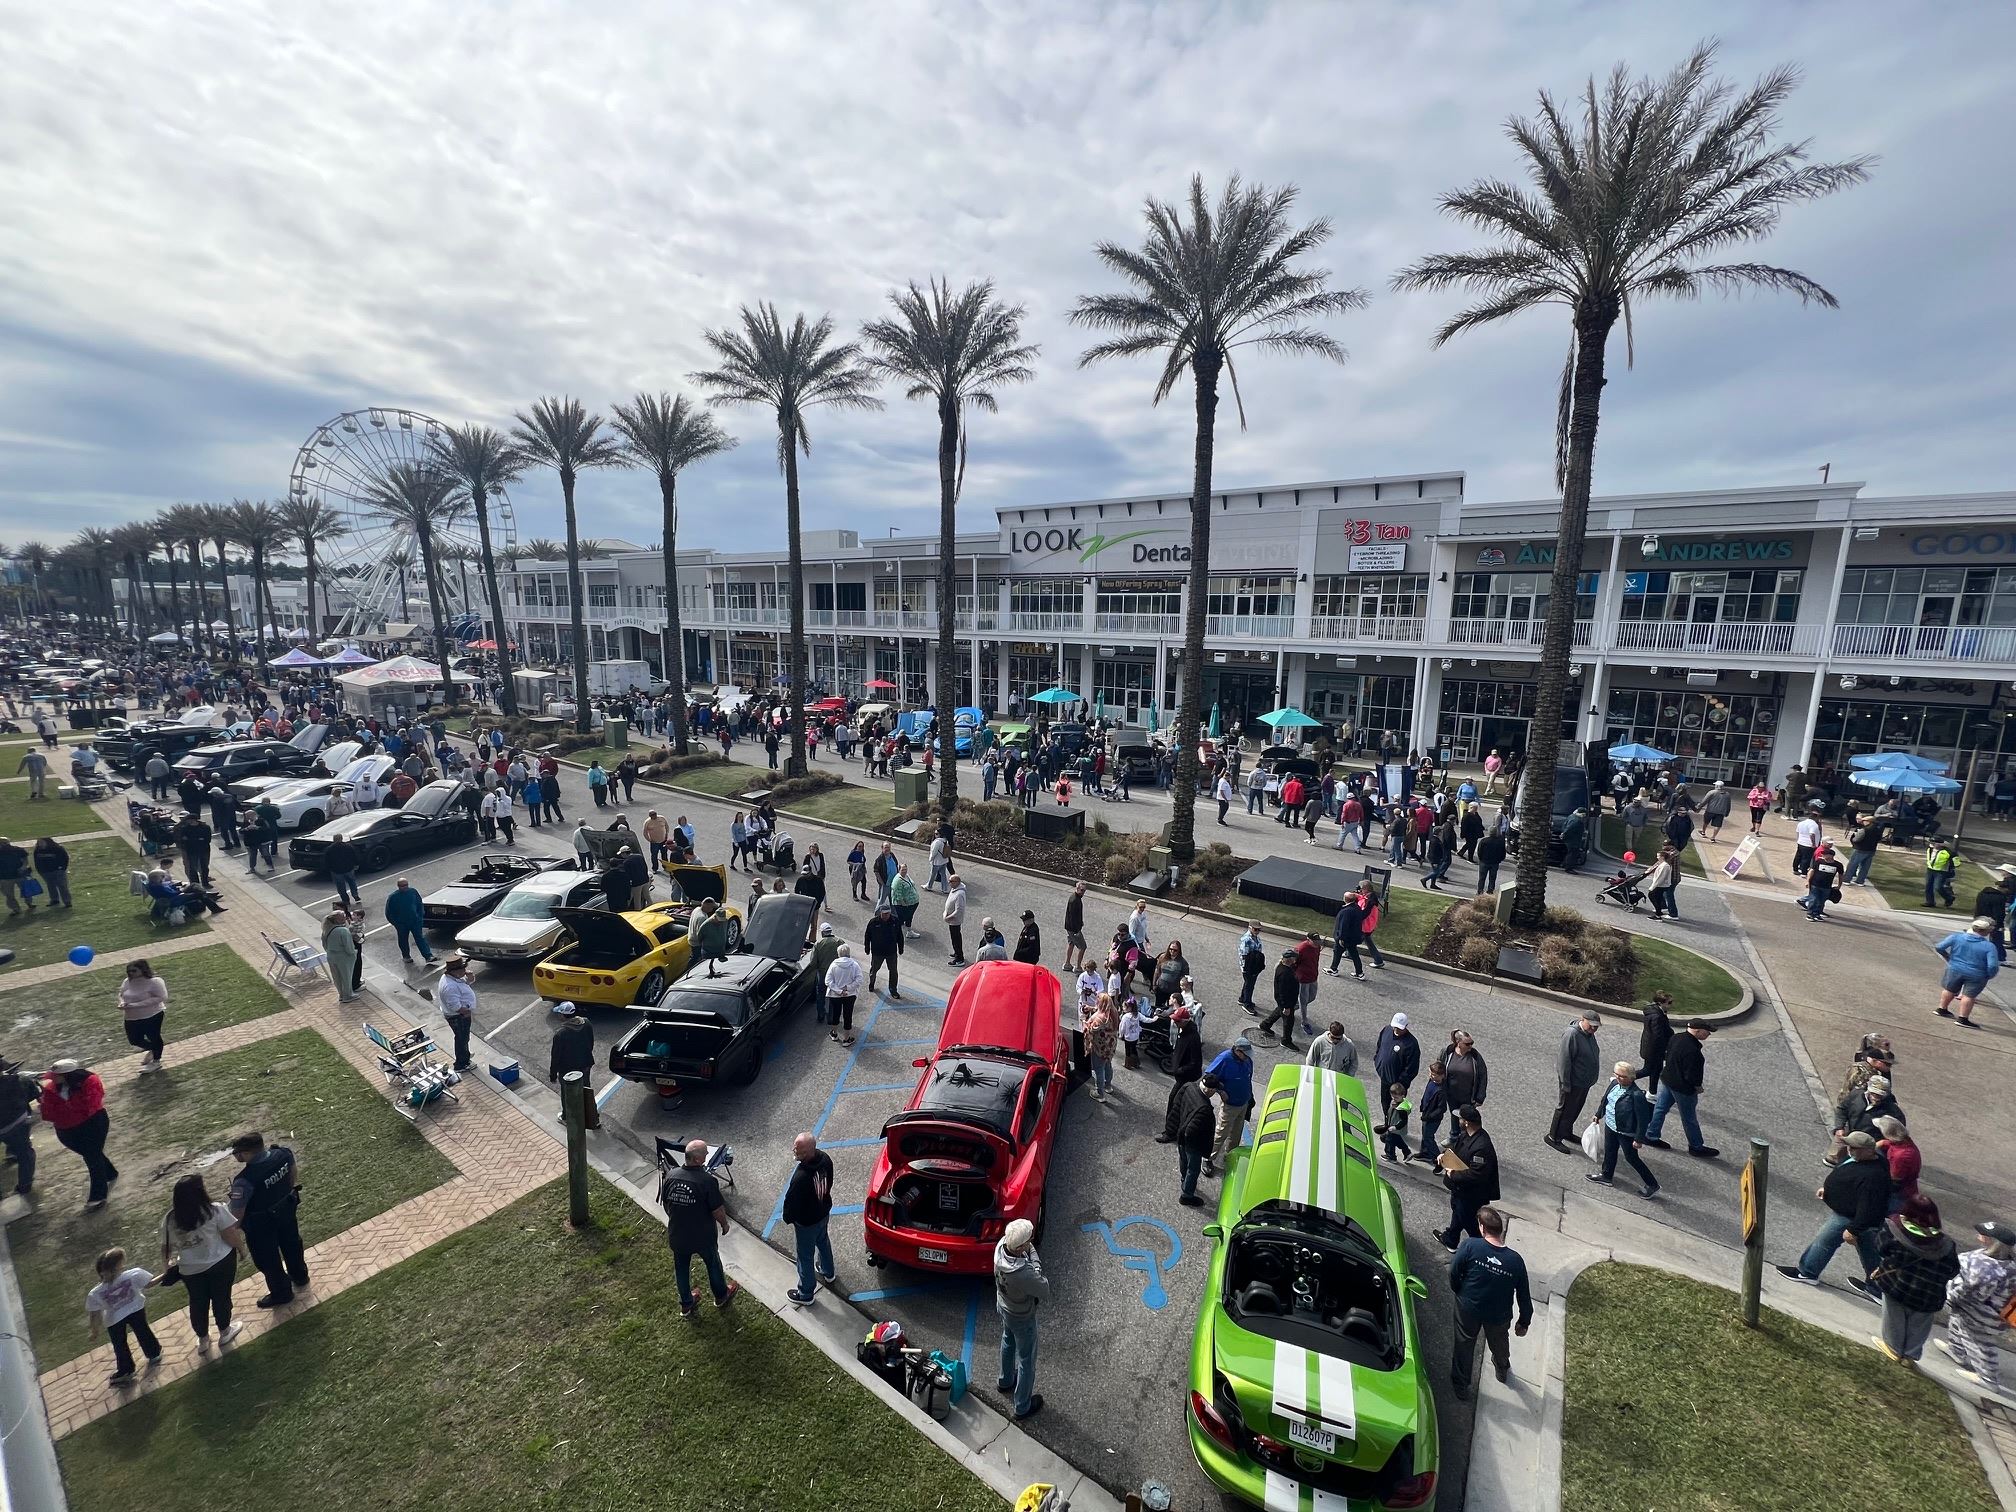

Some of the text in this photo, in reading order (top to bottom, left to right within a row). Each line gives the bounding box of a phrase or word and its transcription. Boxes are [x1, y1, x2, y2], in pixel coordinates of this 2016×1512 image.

[1012, 528, 1082, 553] LOOK
[1344, 518, 1411, 544] $3 Tan
[1133, 543, 1192, 563] Denta
[1517, 540, 1793, 564] AN ANDREWS
[1911, 532, 2016, 556] GOO
[1143, 581, 1163, 589] Spray
[388, 668, 441, 677] ROUSE
[264, 1162, 289, 1189] POLICE
[1291, 1422, 1332, 1446] D12607P
